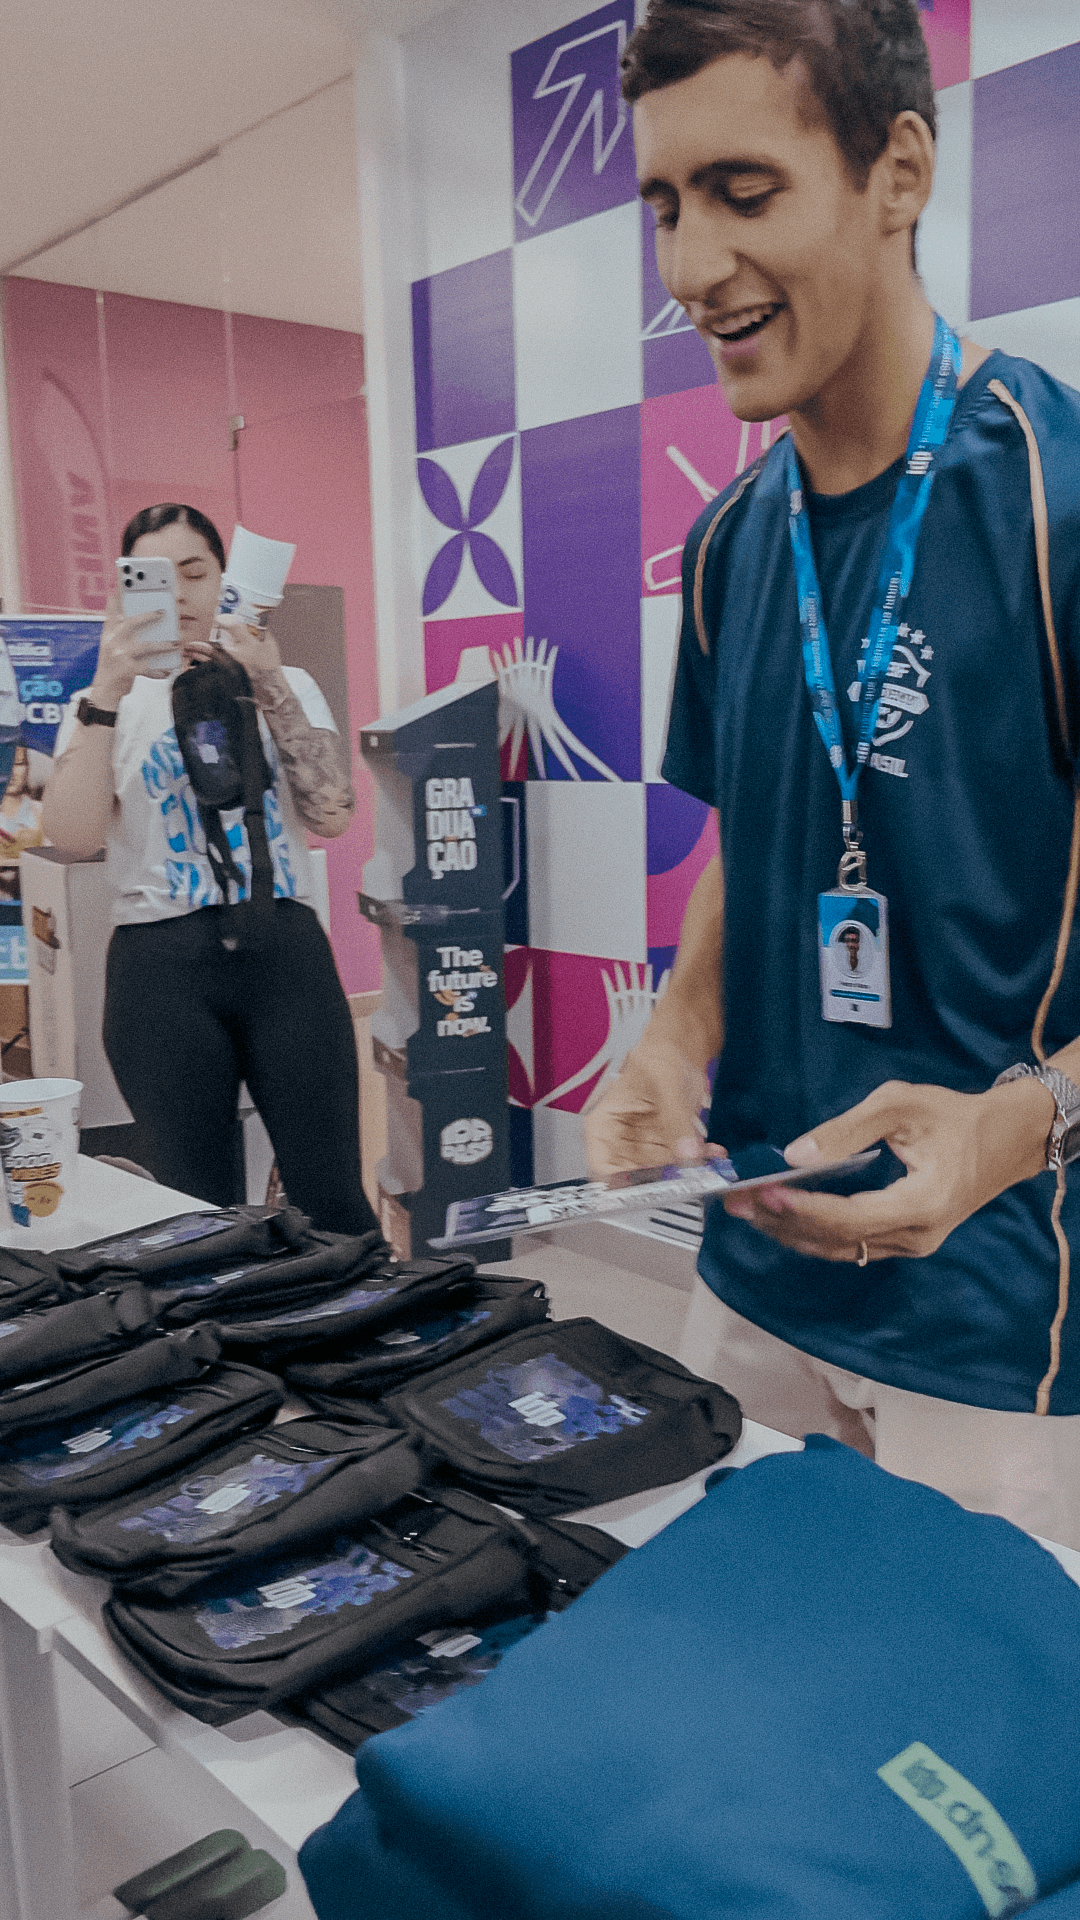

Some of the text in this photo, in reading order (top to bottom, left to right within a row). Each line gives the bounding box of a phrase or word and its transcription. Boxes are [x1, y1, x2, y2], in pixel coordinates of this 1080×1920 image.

[19, 674, 63, 703] ção
[425, 777, 475, 810] GRA
[425, 809, 476, 841] DUA
[436, 946, 483, 968] The
[428, 970, 498, 992] future
[453, 991, 475, 1012] is
[437, 1016, 492, 1037] now.
